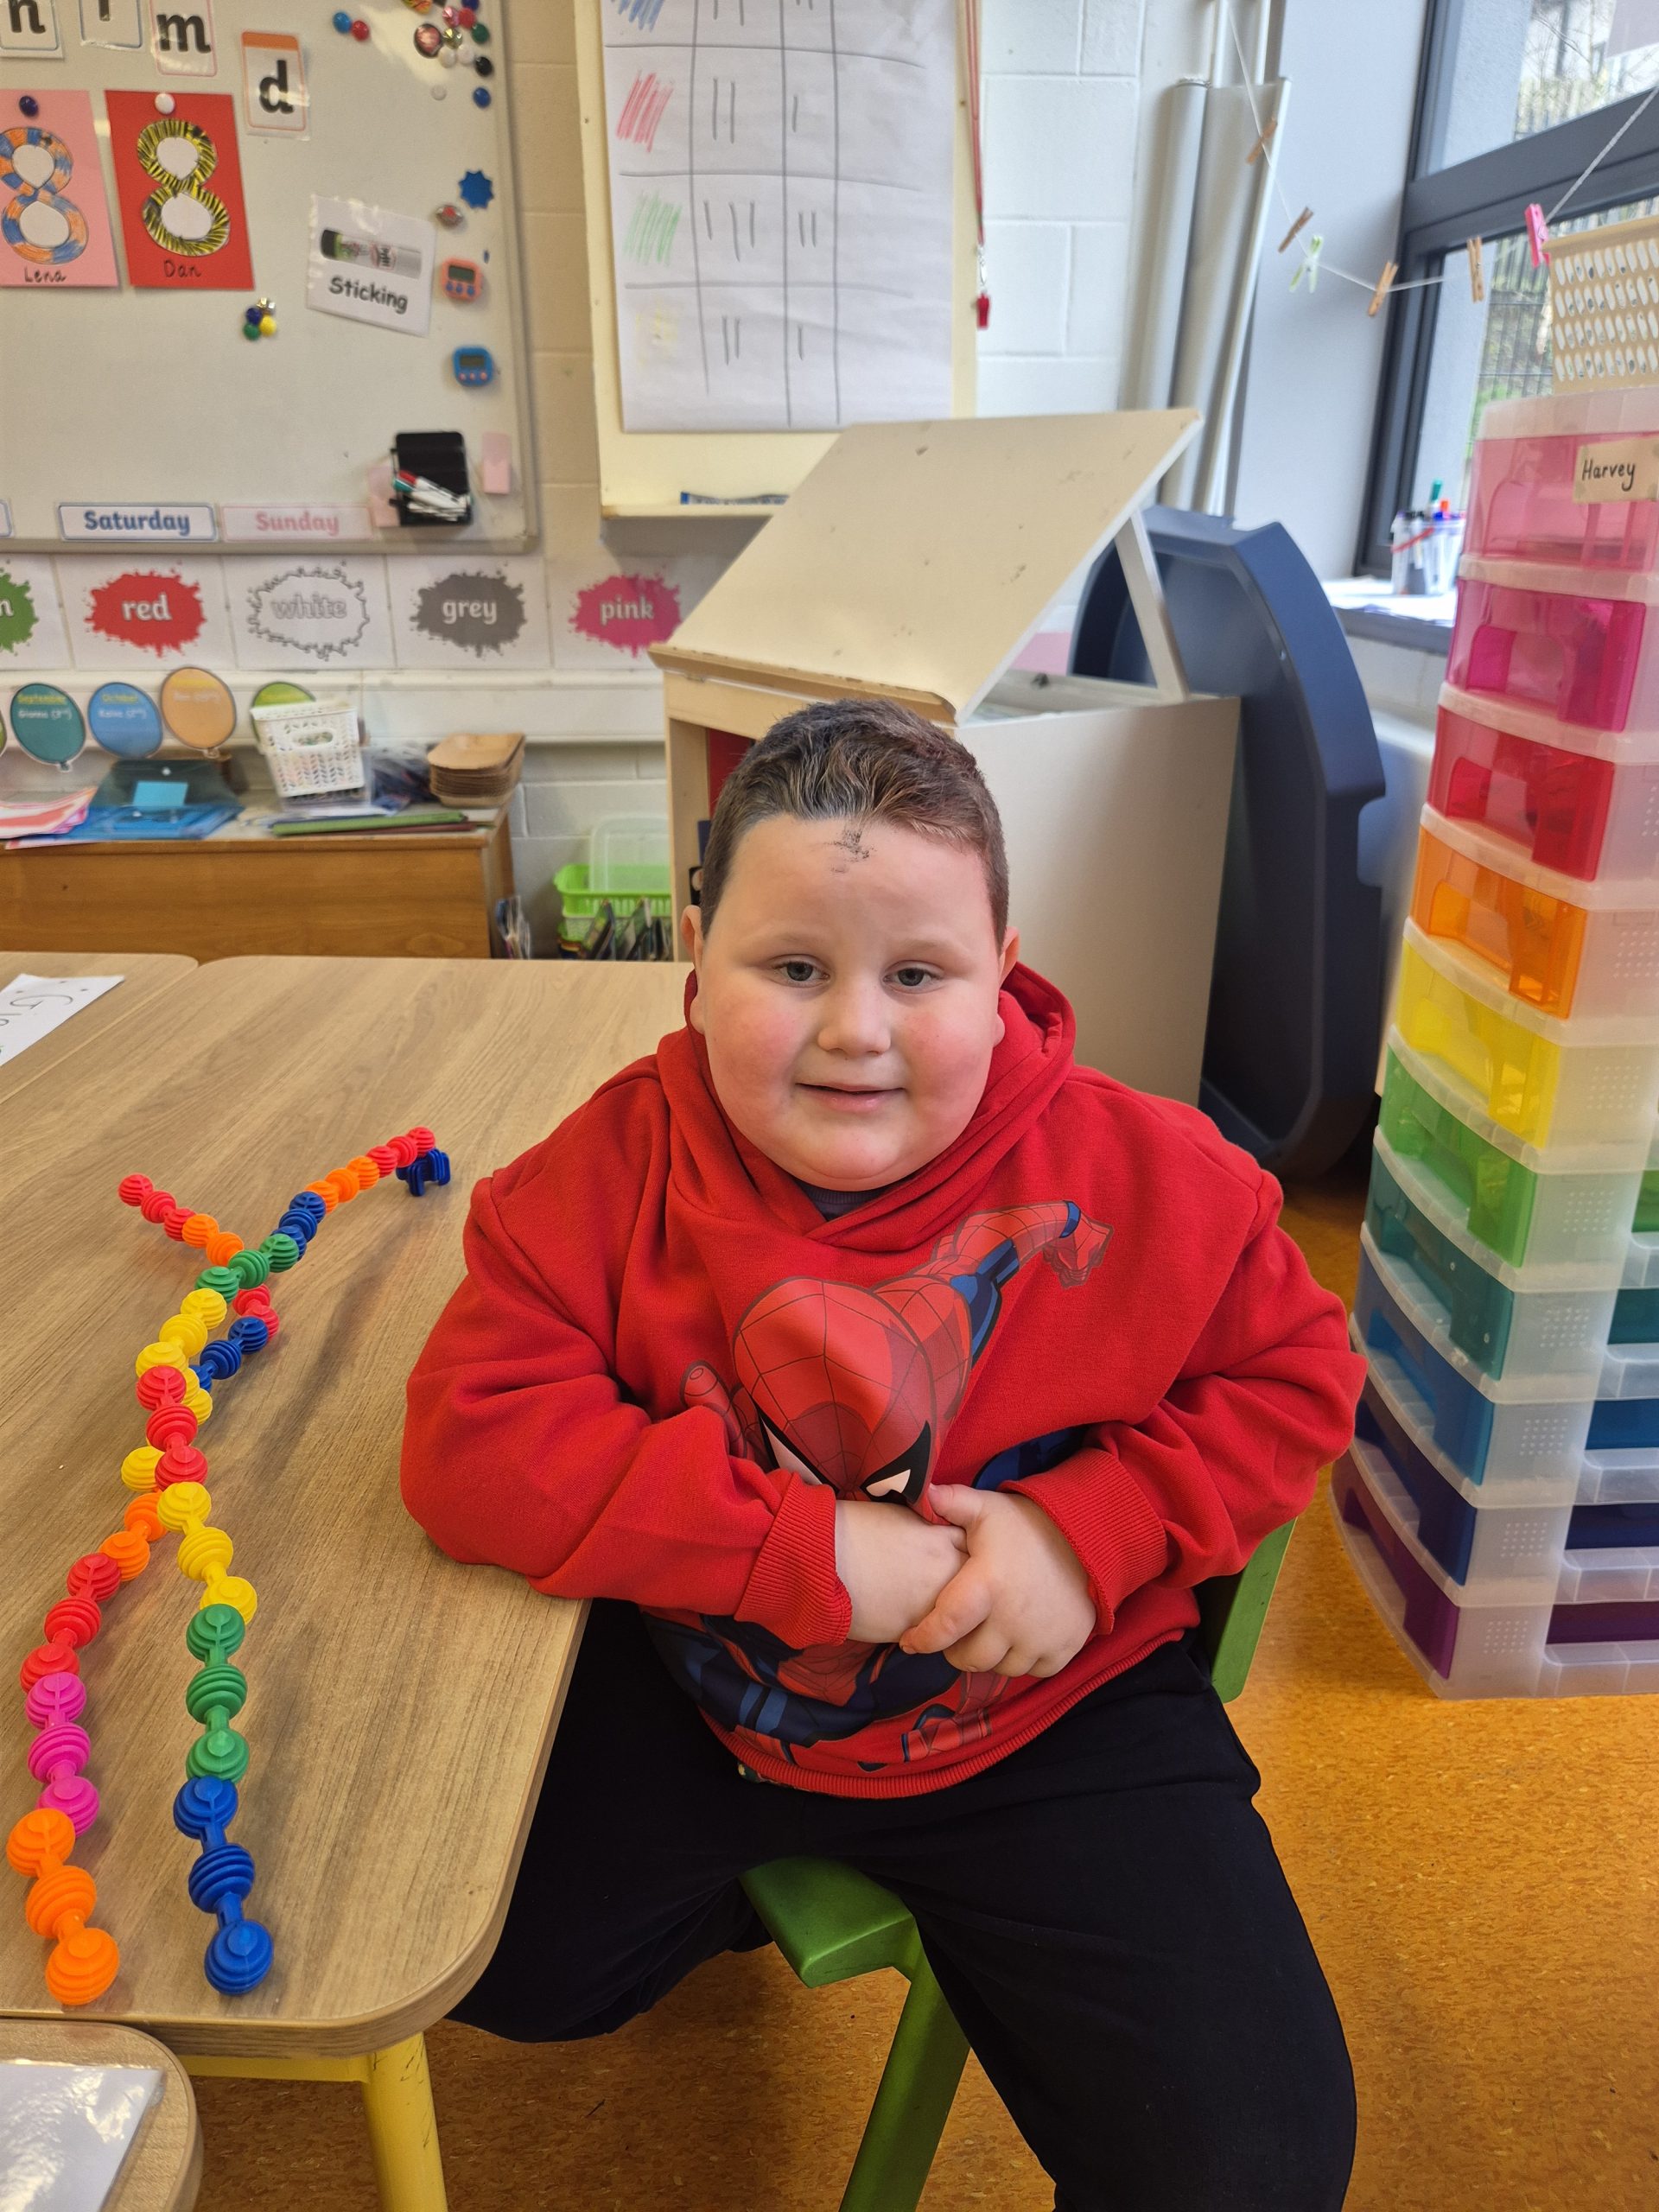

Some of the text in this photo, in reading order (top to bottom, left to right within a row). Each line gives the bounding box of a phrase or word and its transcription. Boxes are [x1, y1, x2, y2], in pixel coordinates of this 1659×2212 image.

[156, 14, 211, 54] m
[258, 60, 295, 115] d
[24, 267, 67, 283] Lena
[163, 259, 201, 278] Dan
[329, 276, 408, 315] Sticking
[1581, 458, 1636, 493] Harvey
[84, 510, 190, 536] Saturday
[258, 511, 339, 536] Sunday
[121, 592, 172, 621] red
[270, 592, 346, 620] white
[442, 598, 498, 625] grey
[600, 594, 654, 627] pink
